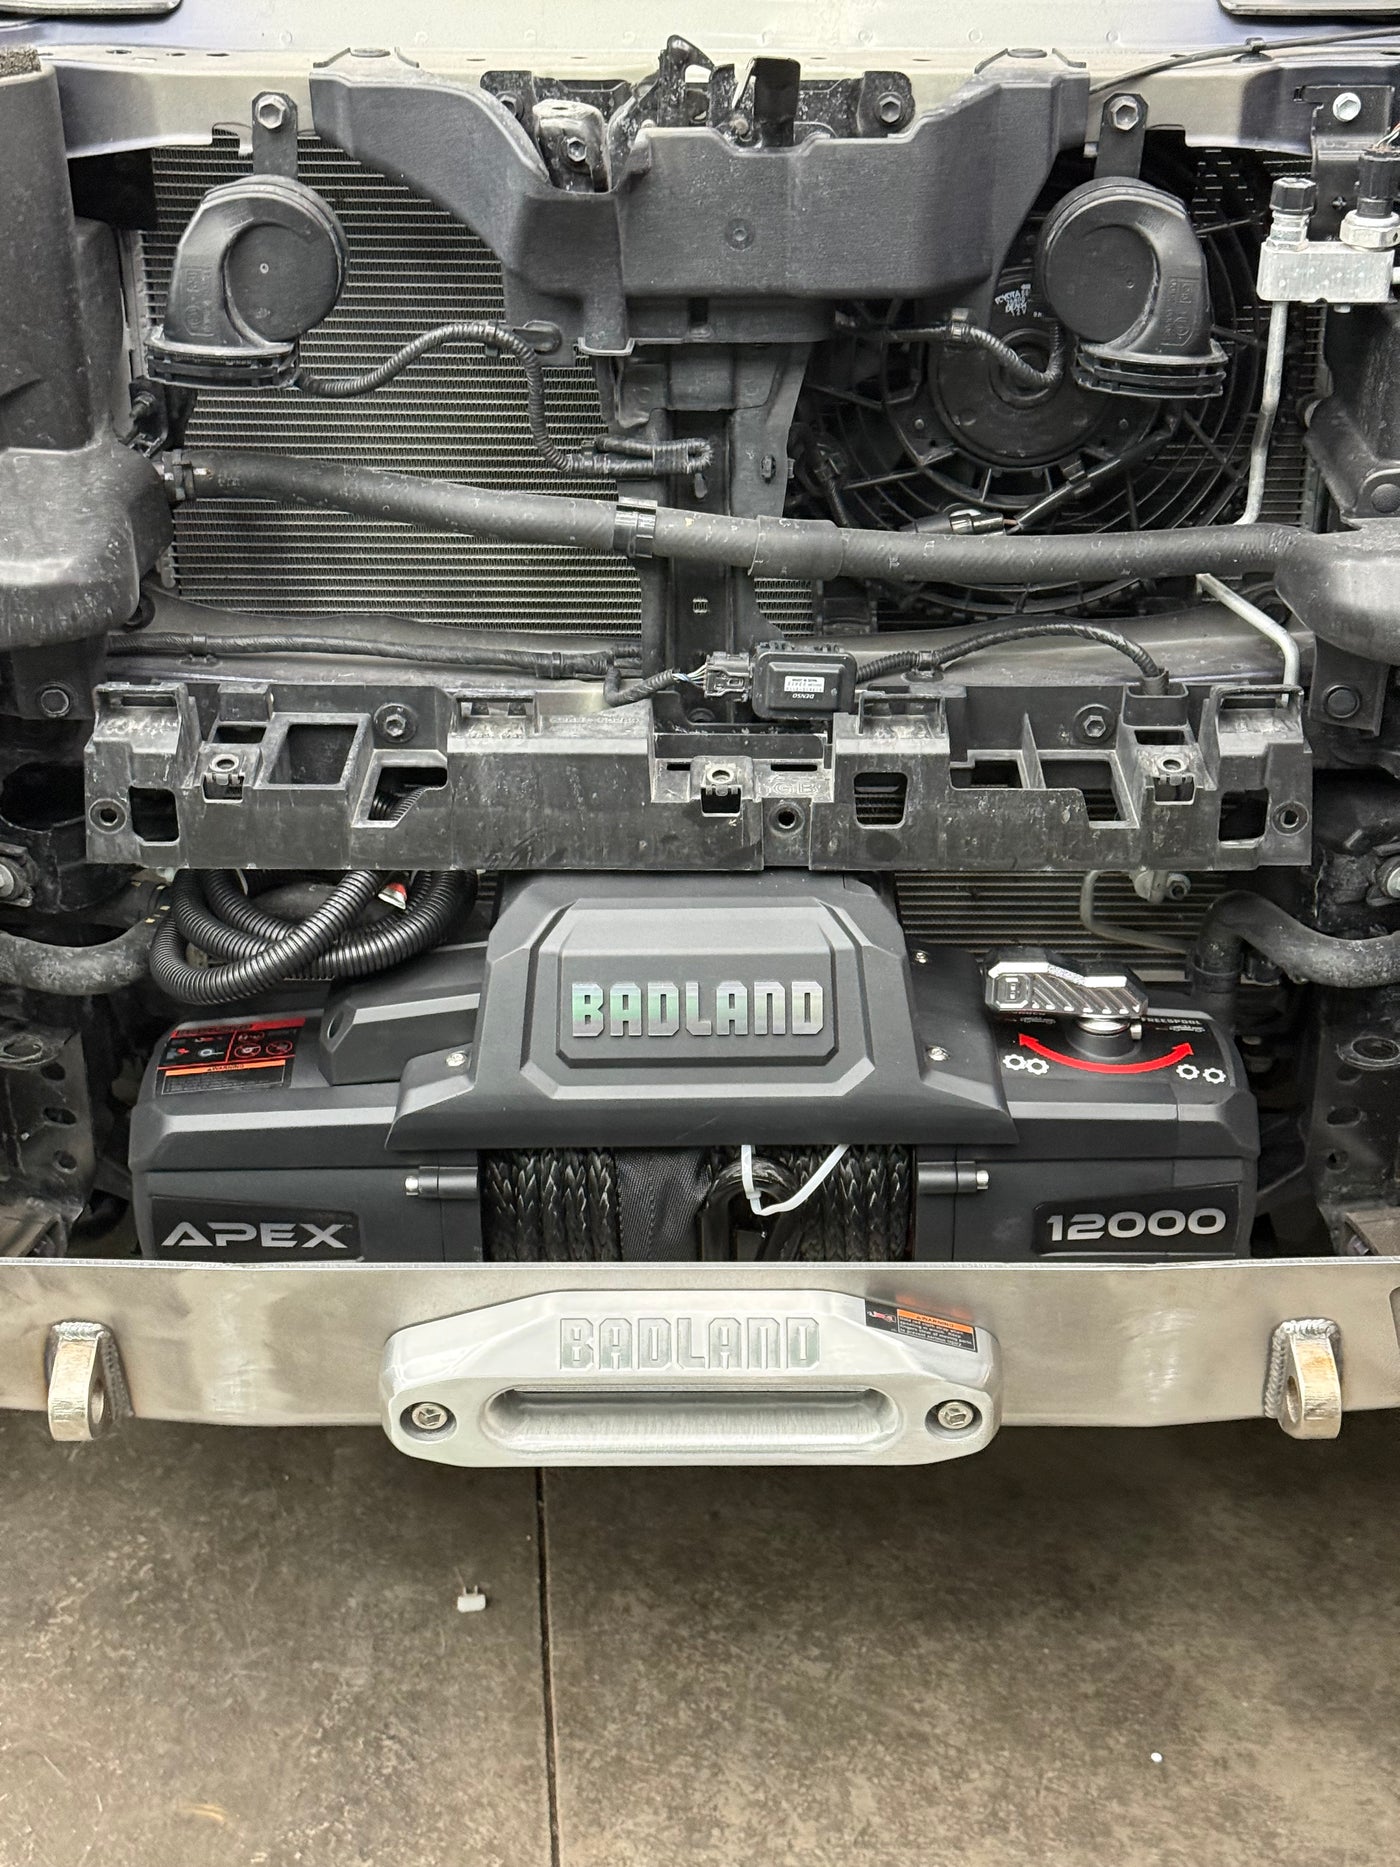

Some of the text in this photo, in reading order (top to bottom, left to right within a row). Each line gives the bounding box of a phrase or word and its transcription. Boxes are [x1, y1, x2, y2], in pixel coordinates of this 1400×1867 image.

[572, 980, 824, 1038] BADLAND
[161, 1221, 348, 1248] APEX
[1047, 1208, 1227, 1241] 12000
[922, 1316, 954, 1328] WARNING
[559, 1316, 822, 1371] BADLAND
